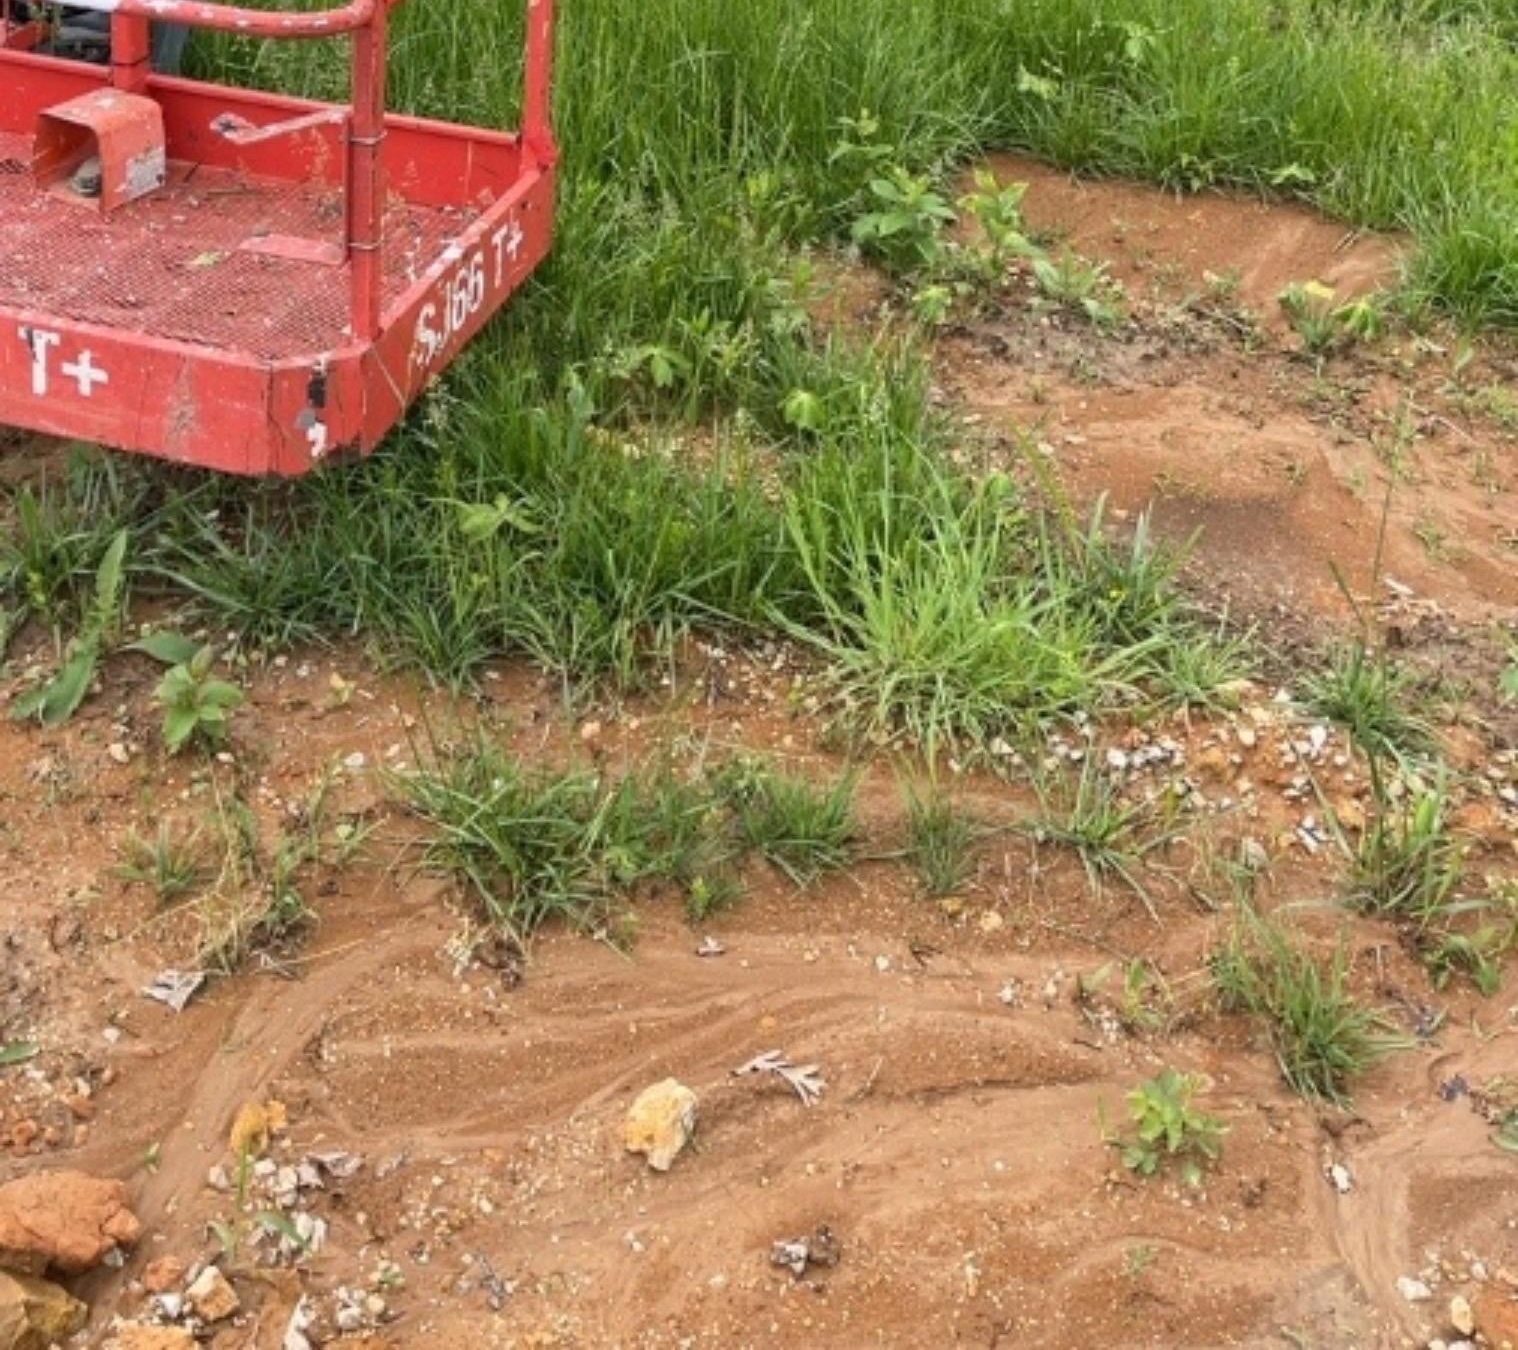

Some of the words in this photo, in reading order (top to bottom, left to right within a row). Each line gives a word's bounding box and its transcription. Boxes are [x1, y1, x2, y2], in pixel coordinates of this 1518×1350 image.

[415, 251, 485, 367] SJ66
[492, 220, 523, 289] T+
[17, 326, 109, 397] T+
